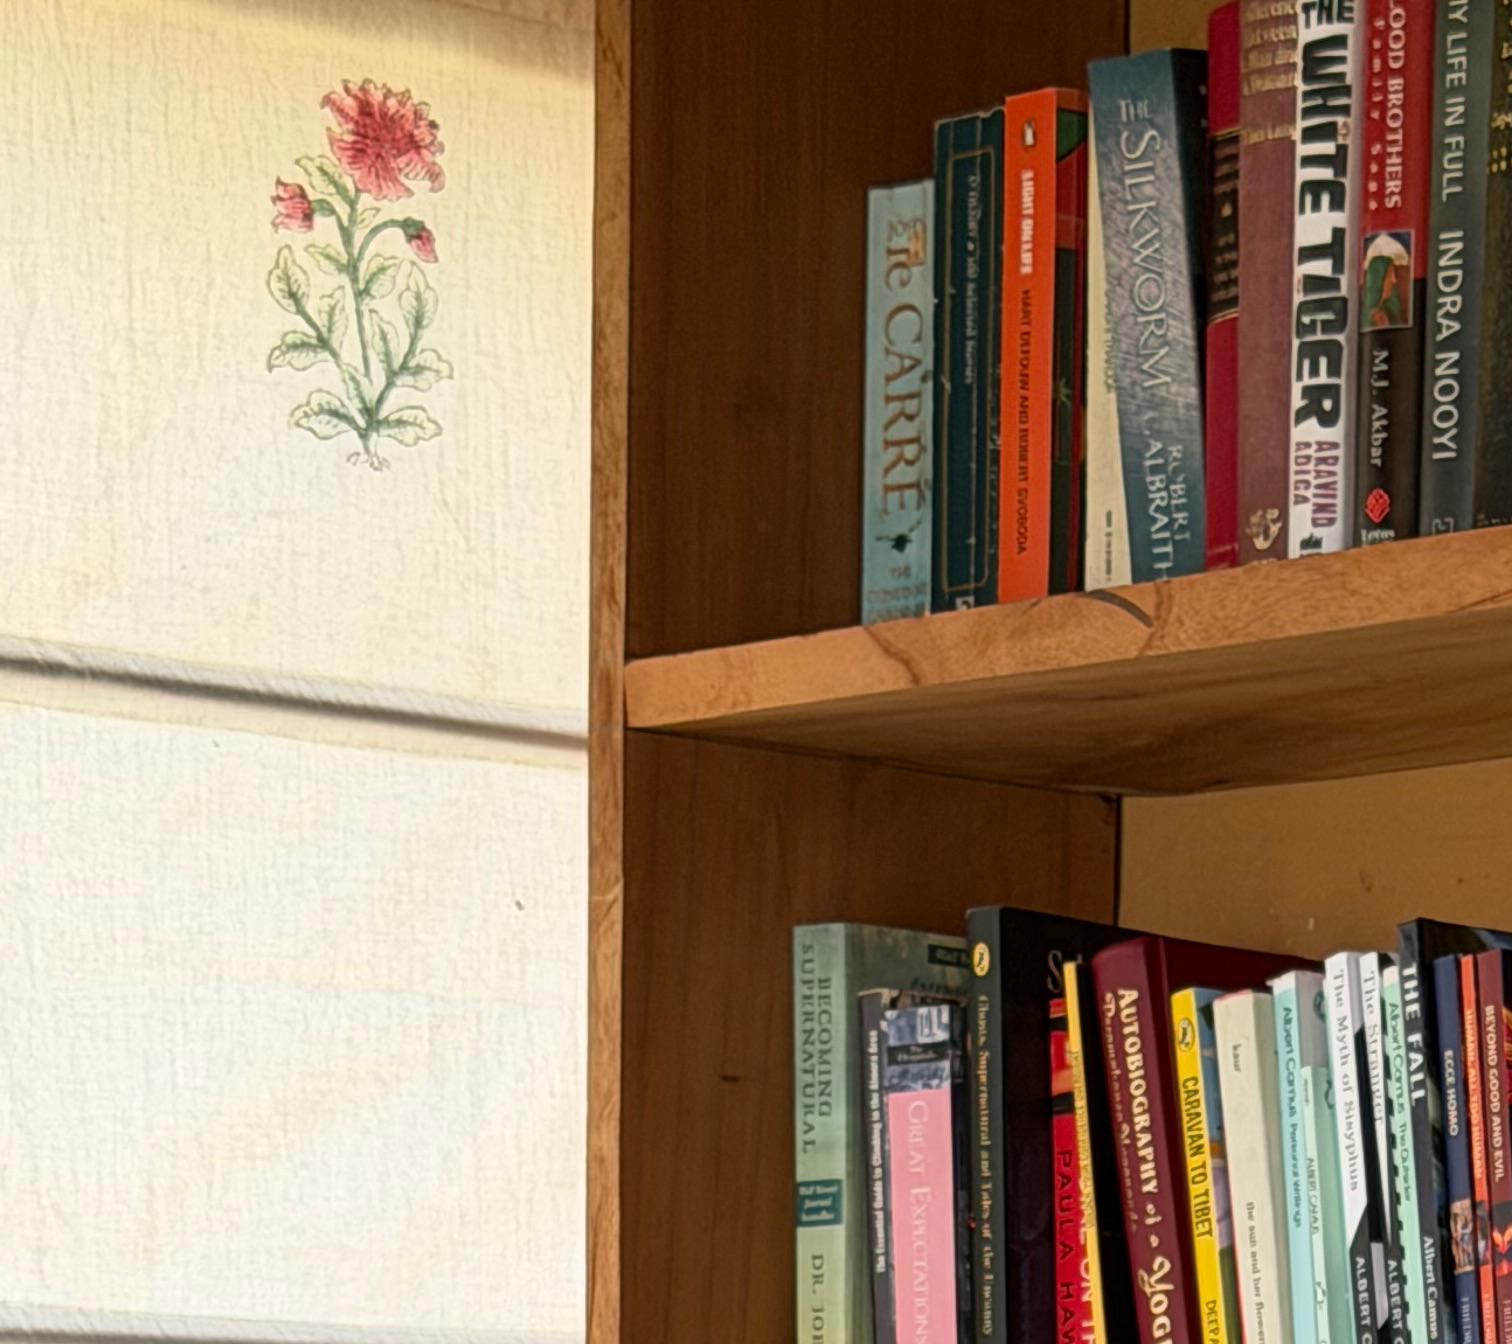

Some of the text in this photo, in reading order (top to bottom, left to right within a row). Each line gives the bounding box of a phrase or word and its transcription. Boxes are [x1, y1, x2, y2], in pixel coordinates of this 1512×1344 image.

[1442, 32, 1468, 202] LIFE IN FULL
[1130, 130, 1174, 388] SILKWORM
[1370, 349, 1389, 468] M.J. Akbar
[1432, 231, 1464, 460] INDRA NOOYI
[1293, 440, 1313, 507] ADIGA
[1311, 440, 1341, 528] ARAVIND
[800, 944, 816, 1154] SUPERNATURAL
[817, 977, 833, 1118] BECOMING
[1402, 962, 1426, 1107] THE FALL
[1182, 1077, 1214, 1240] CARAVAN TO TIBET
[1354, 1256, 1371, 1328] ALBERT
